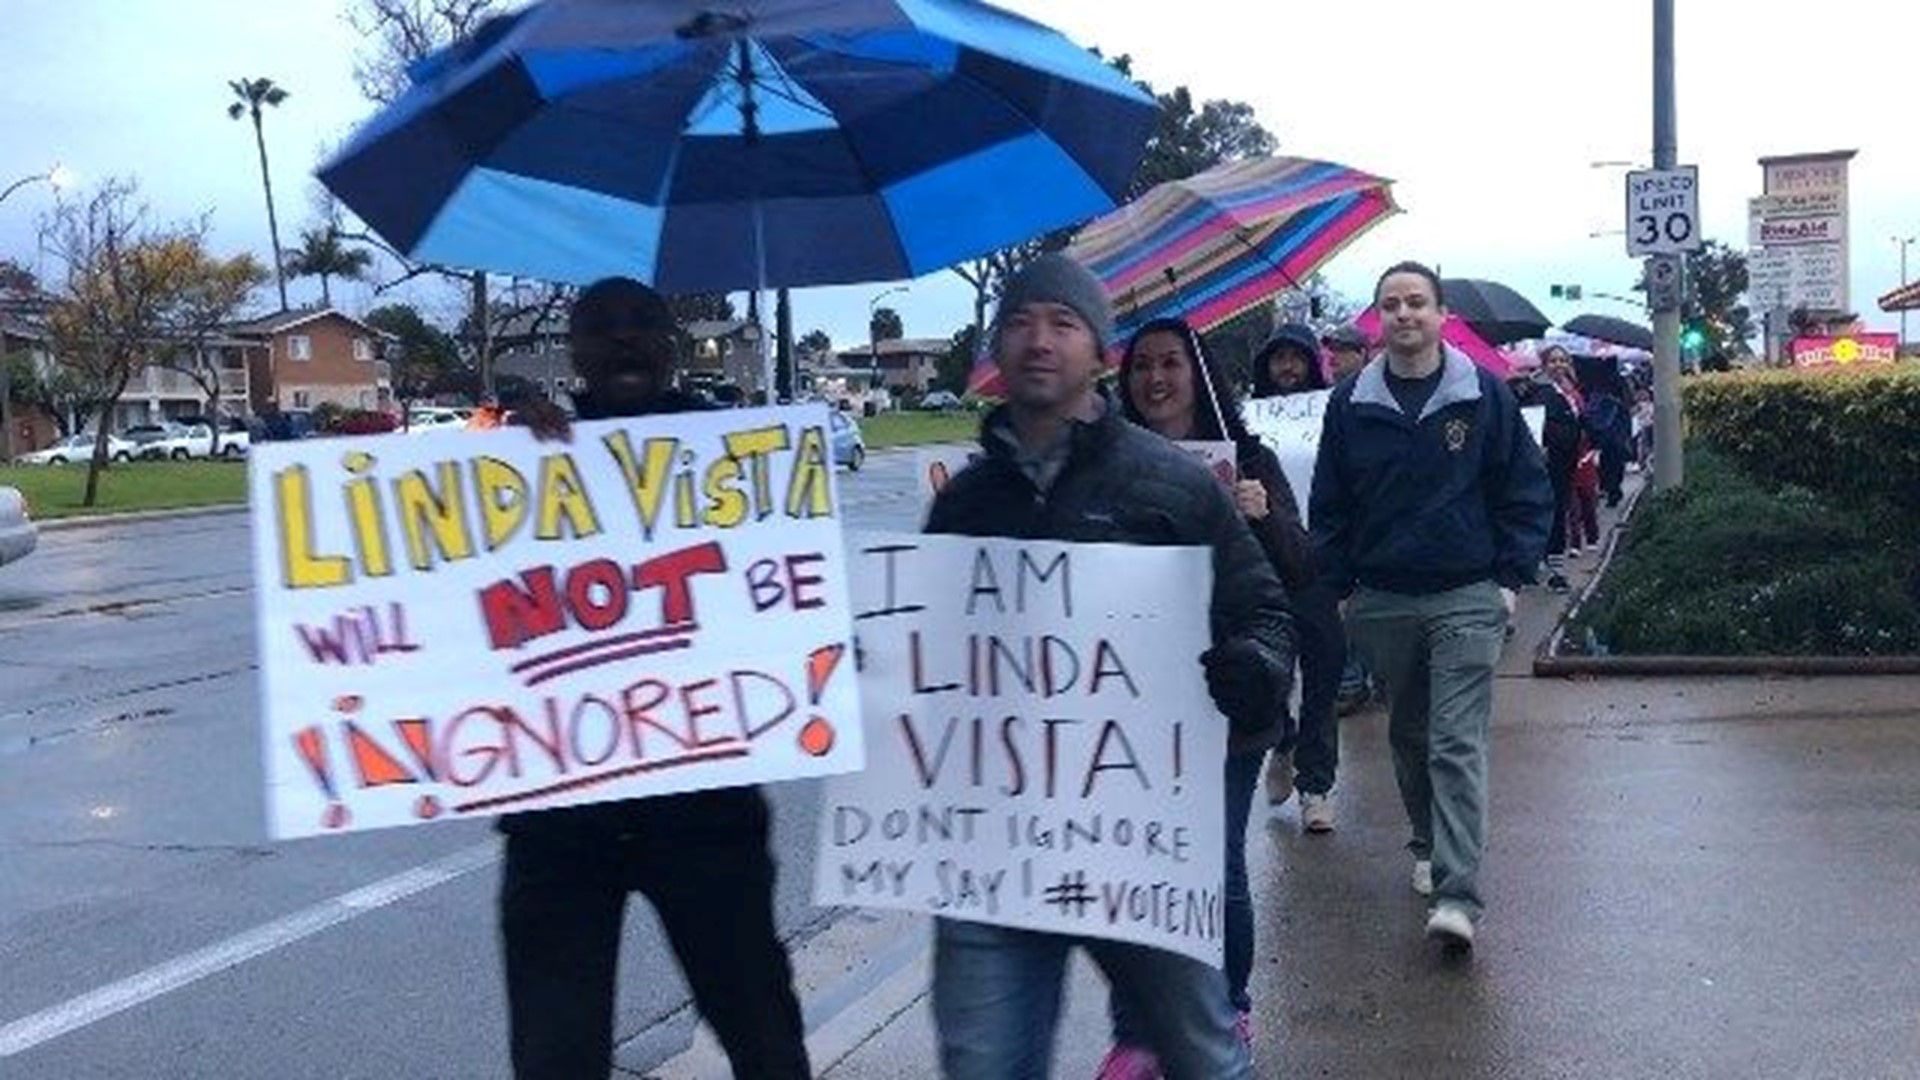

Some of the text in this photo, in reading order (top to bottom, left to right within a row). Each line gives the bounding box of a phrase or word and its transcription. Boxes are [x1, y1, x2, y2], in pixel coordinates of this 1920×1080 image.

[1636, 212, 1691, 245] 30
[1640, 193, 1684, 211] LIMIT
[477, 541, 727, 650] NOT
[745, 553, 826, 612] BE
[856, 545, 926, 619] I
[966, 548, 1072, 618] AM
[900, 713, 1189, 800] VISTA!
[834, 804, 1191, 863] DONT IGNORE
[841, 859, 915, 898] MY
